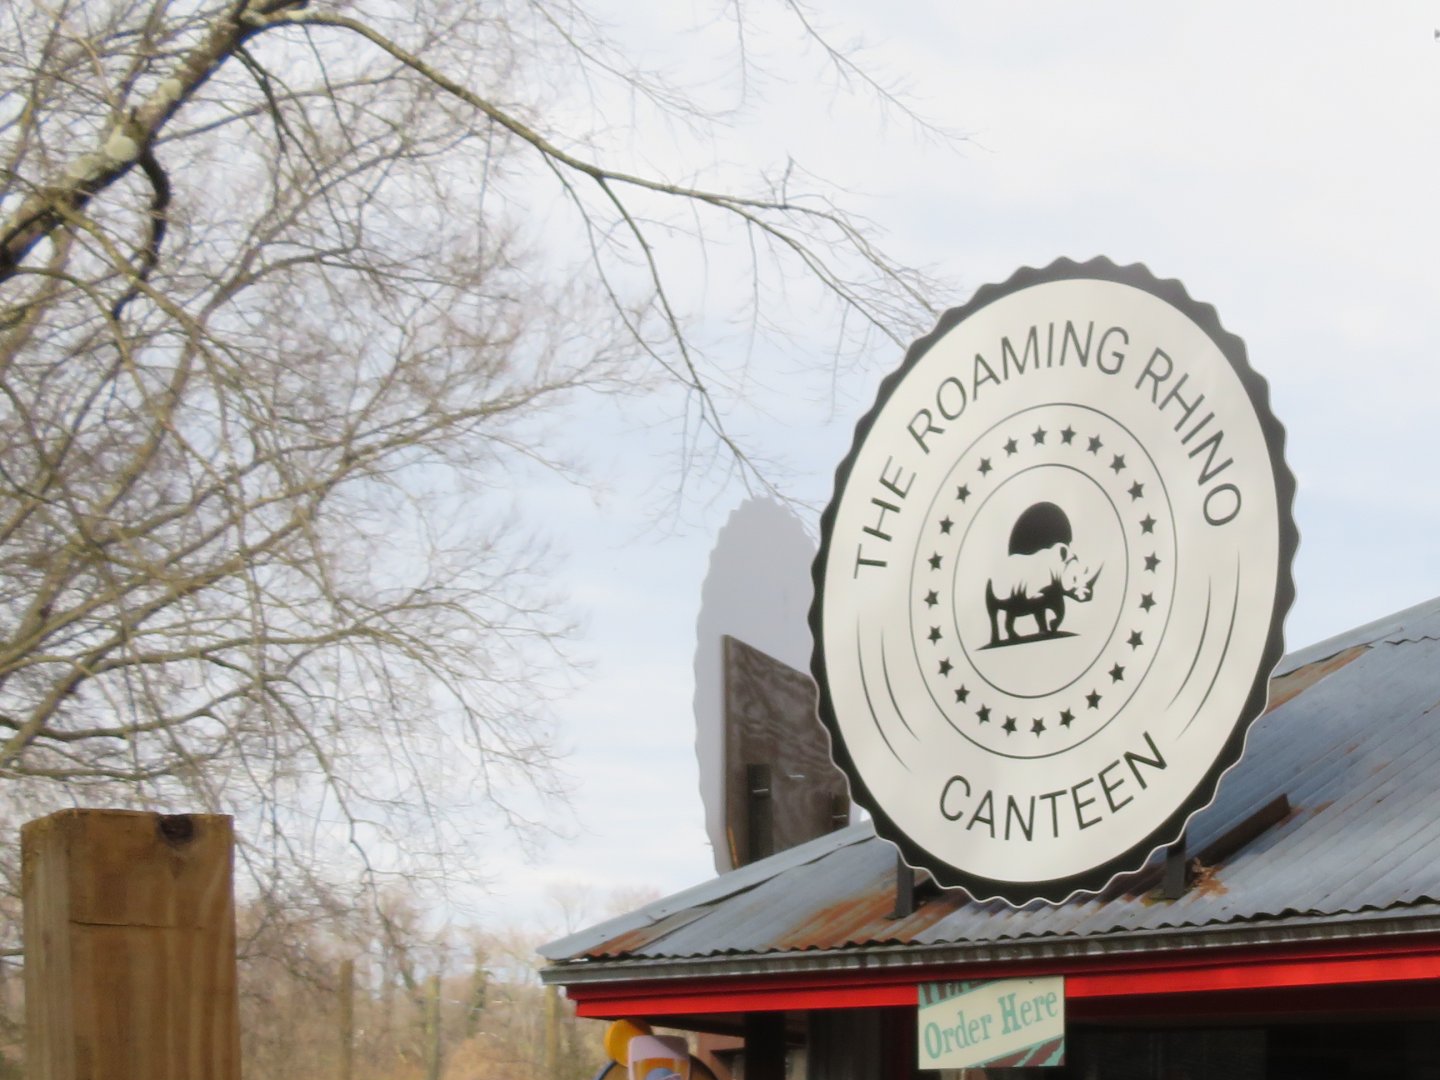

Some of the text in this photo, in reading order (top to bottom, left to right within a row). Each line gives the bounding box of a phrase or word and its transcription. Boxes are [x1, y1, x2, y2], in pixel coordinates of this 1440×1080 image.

[853, 319, 1243, 580] THE ROAMING RHINO
[938, 730, 1168, 842] CANTEEN
[924, 991, 1058, 1060] Order Here
